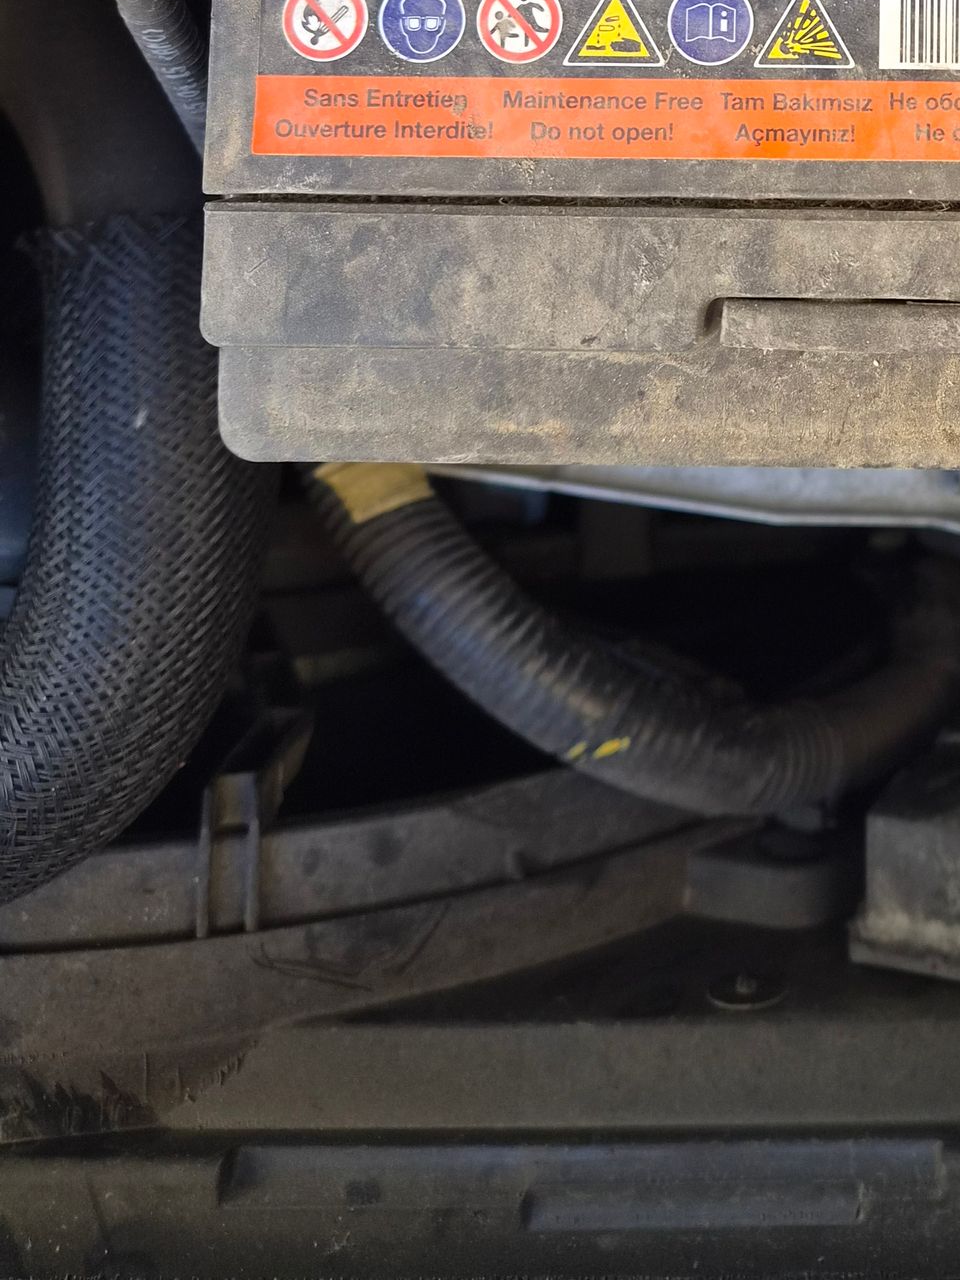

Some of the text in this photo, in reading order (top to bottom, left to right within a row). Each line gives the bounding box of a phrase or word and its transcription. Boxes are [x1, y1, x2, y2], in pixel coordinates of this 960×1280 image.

[304, 88, 468, 109] Sans Entretien
[502, 90, 704, 111] Maintenance Free
[720, 92, 766, 112] Tam
[889, 92, 918, 111] Не
[275, 118, 495, 140] Ouverture Interdite!
[530, 122, 674, 144] Do not open!
[914, 123, 945, 142] Не
